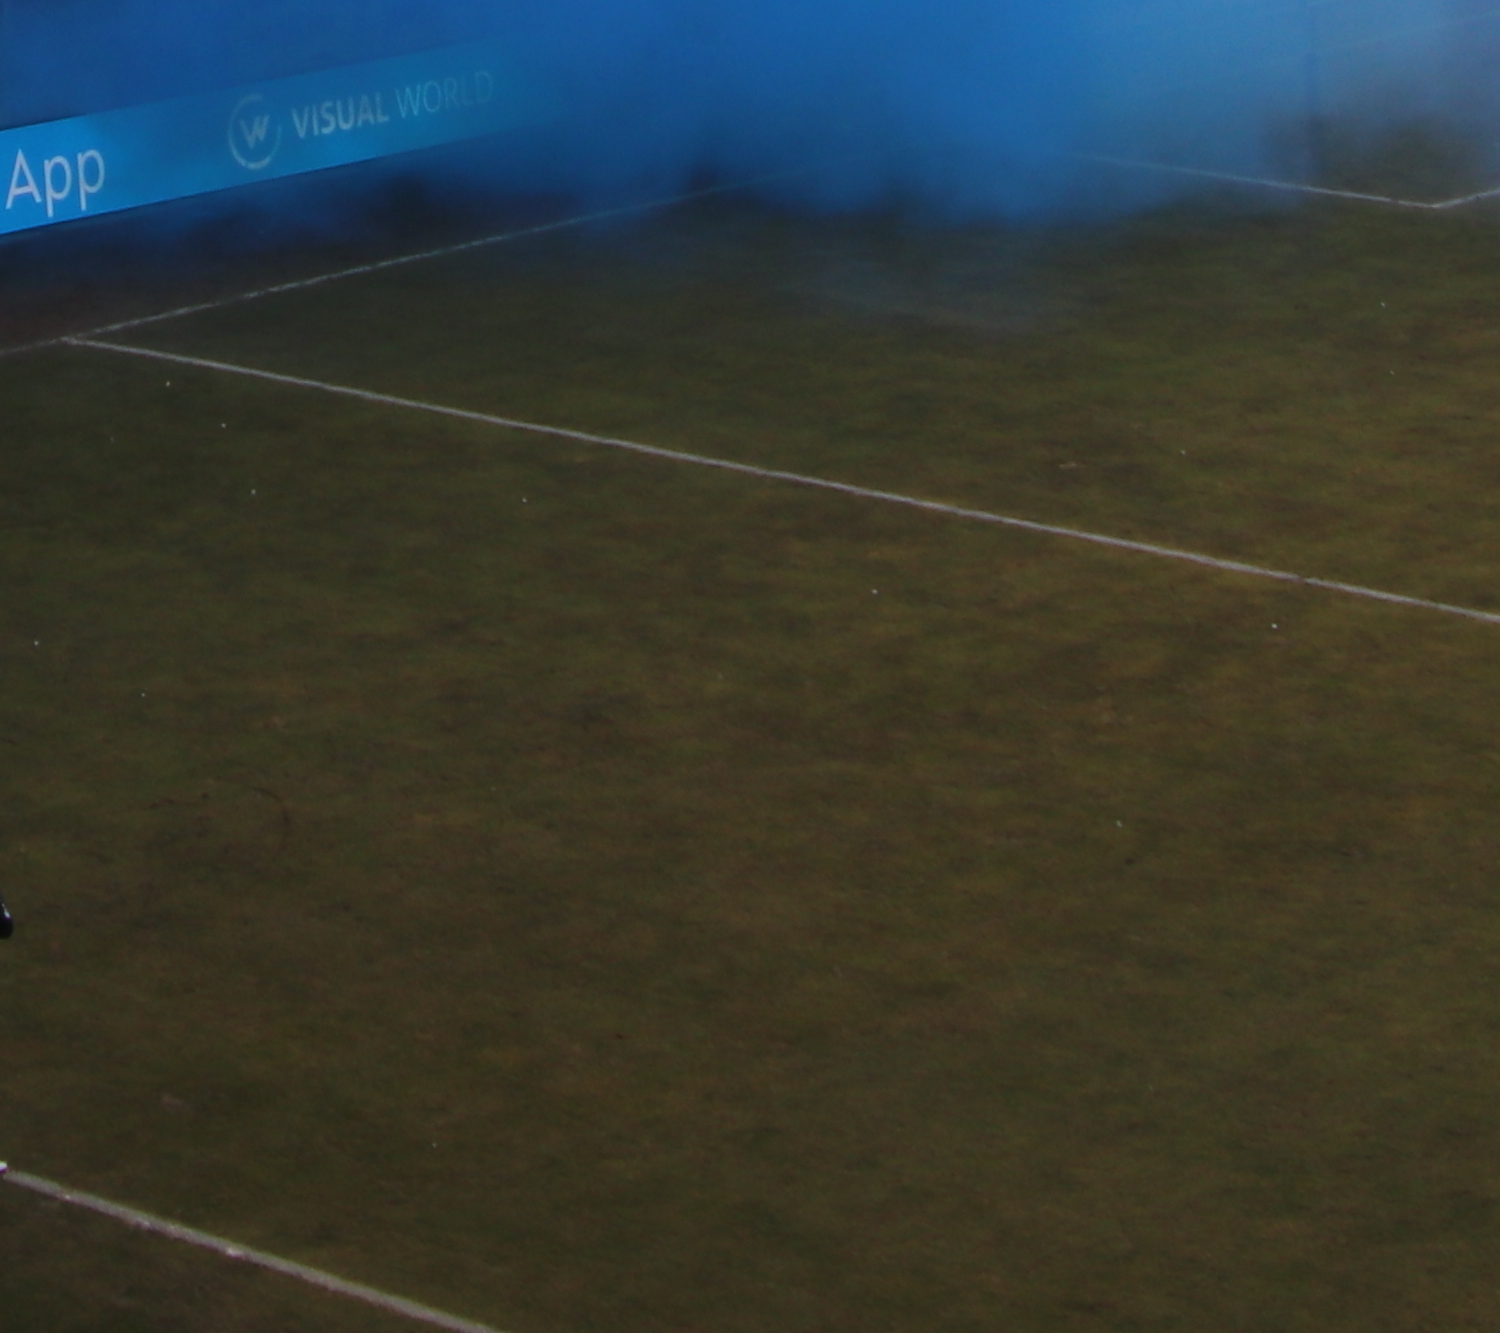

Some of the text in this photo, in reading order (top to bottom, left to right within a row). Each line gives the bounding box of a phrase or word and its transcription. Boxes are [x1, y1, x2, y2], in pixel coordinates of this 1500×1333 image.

[290, 89, 390, 140] VISUAL
[395, 69, 495, 120] WORLD
[4, 143, 107, 225] App
